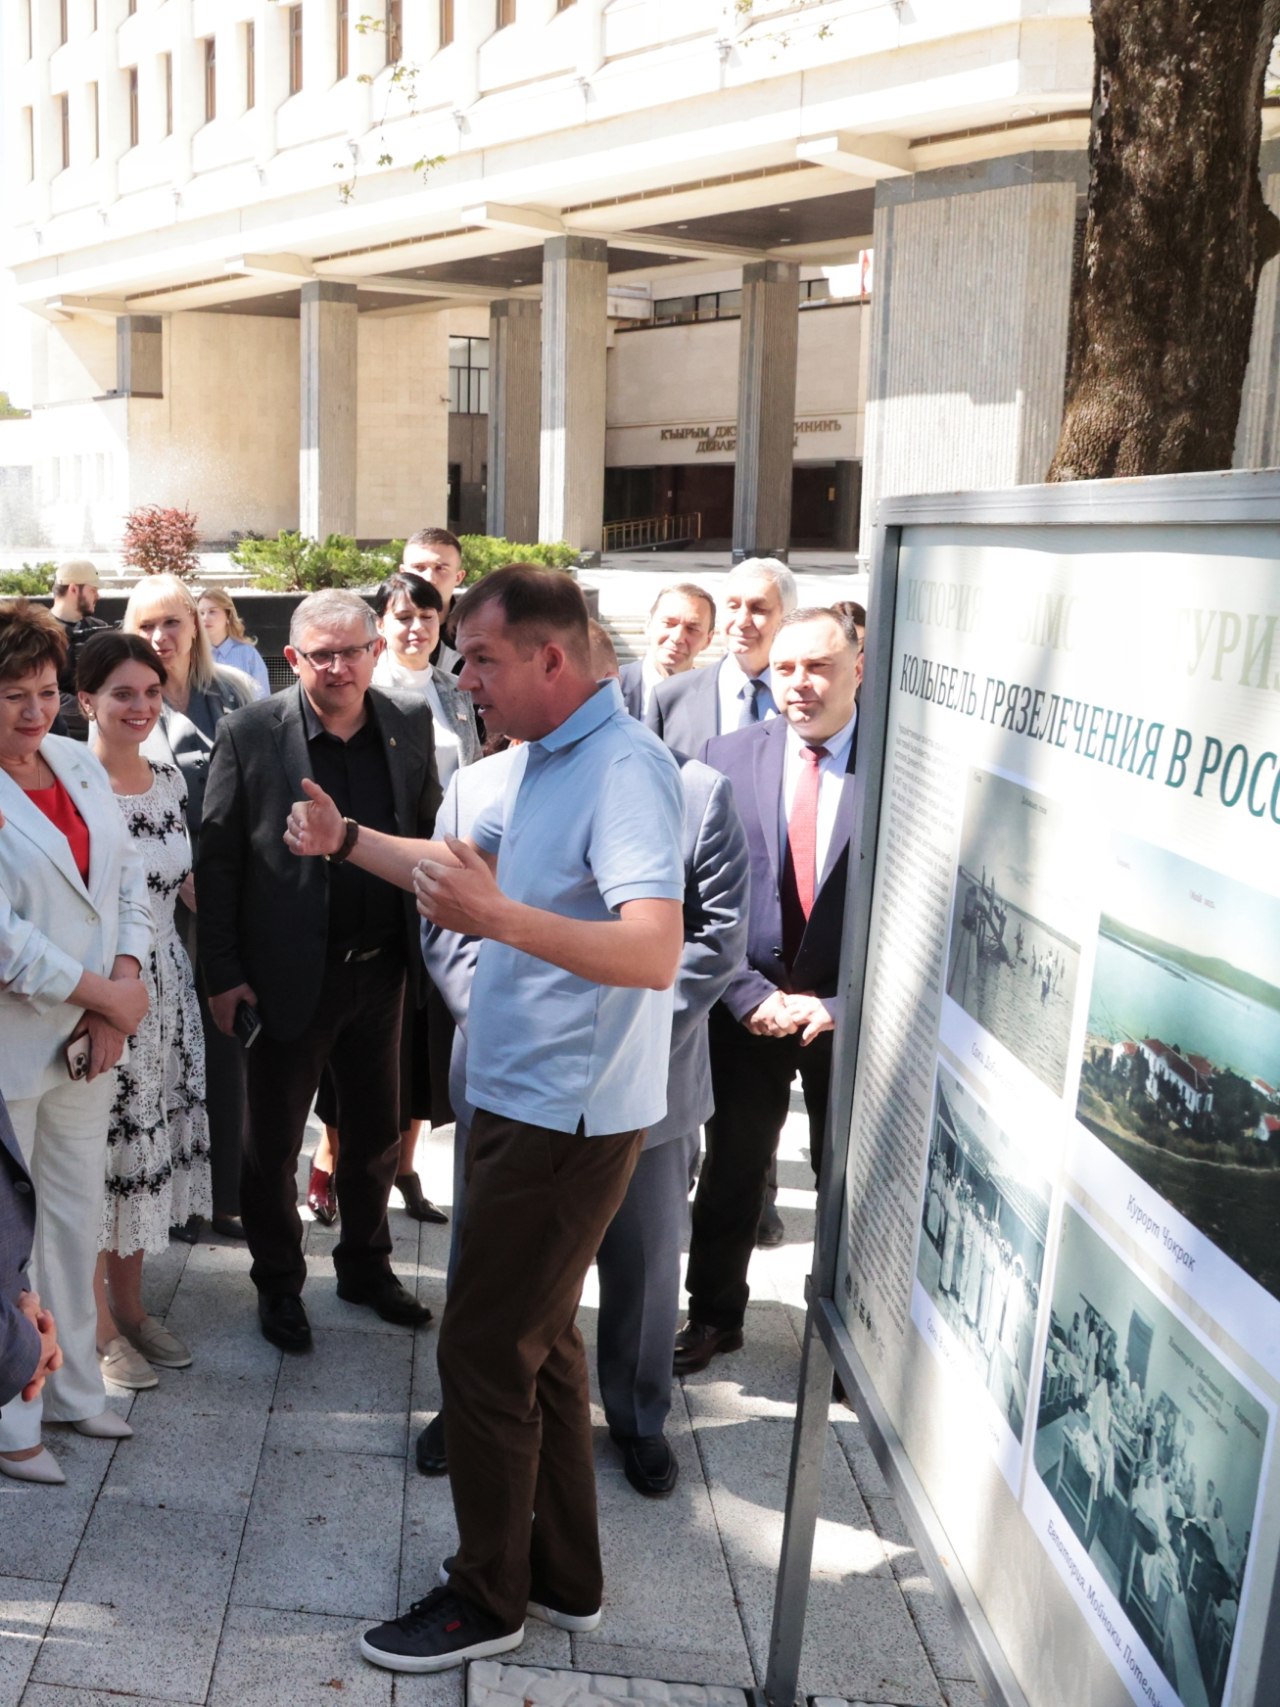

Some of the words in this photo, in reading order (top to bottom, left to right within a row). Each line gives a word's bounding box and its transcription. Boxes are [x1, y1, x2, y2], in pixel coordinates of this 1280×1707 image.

[899, 653, 978, 716] КОЛЫБЕЛЬ
[980, 676, 1166, 781] ГРЯЗЕЛЕЧЕНИЯ
[1164, 727, 1193, 789] В
[1126, 1194, 1161, 1239] Курорт
[1162, 1226, 1196, 1273] Чокрак
[1047, 1518, 1087, 1593] Евпатория.
[1087, 1584, 1122, 1651] Мойнаки.
